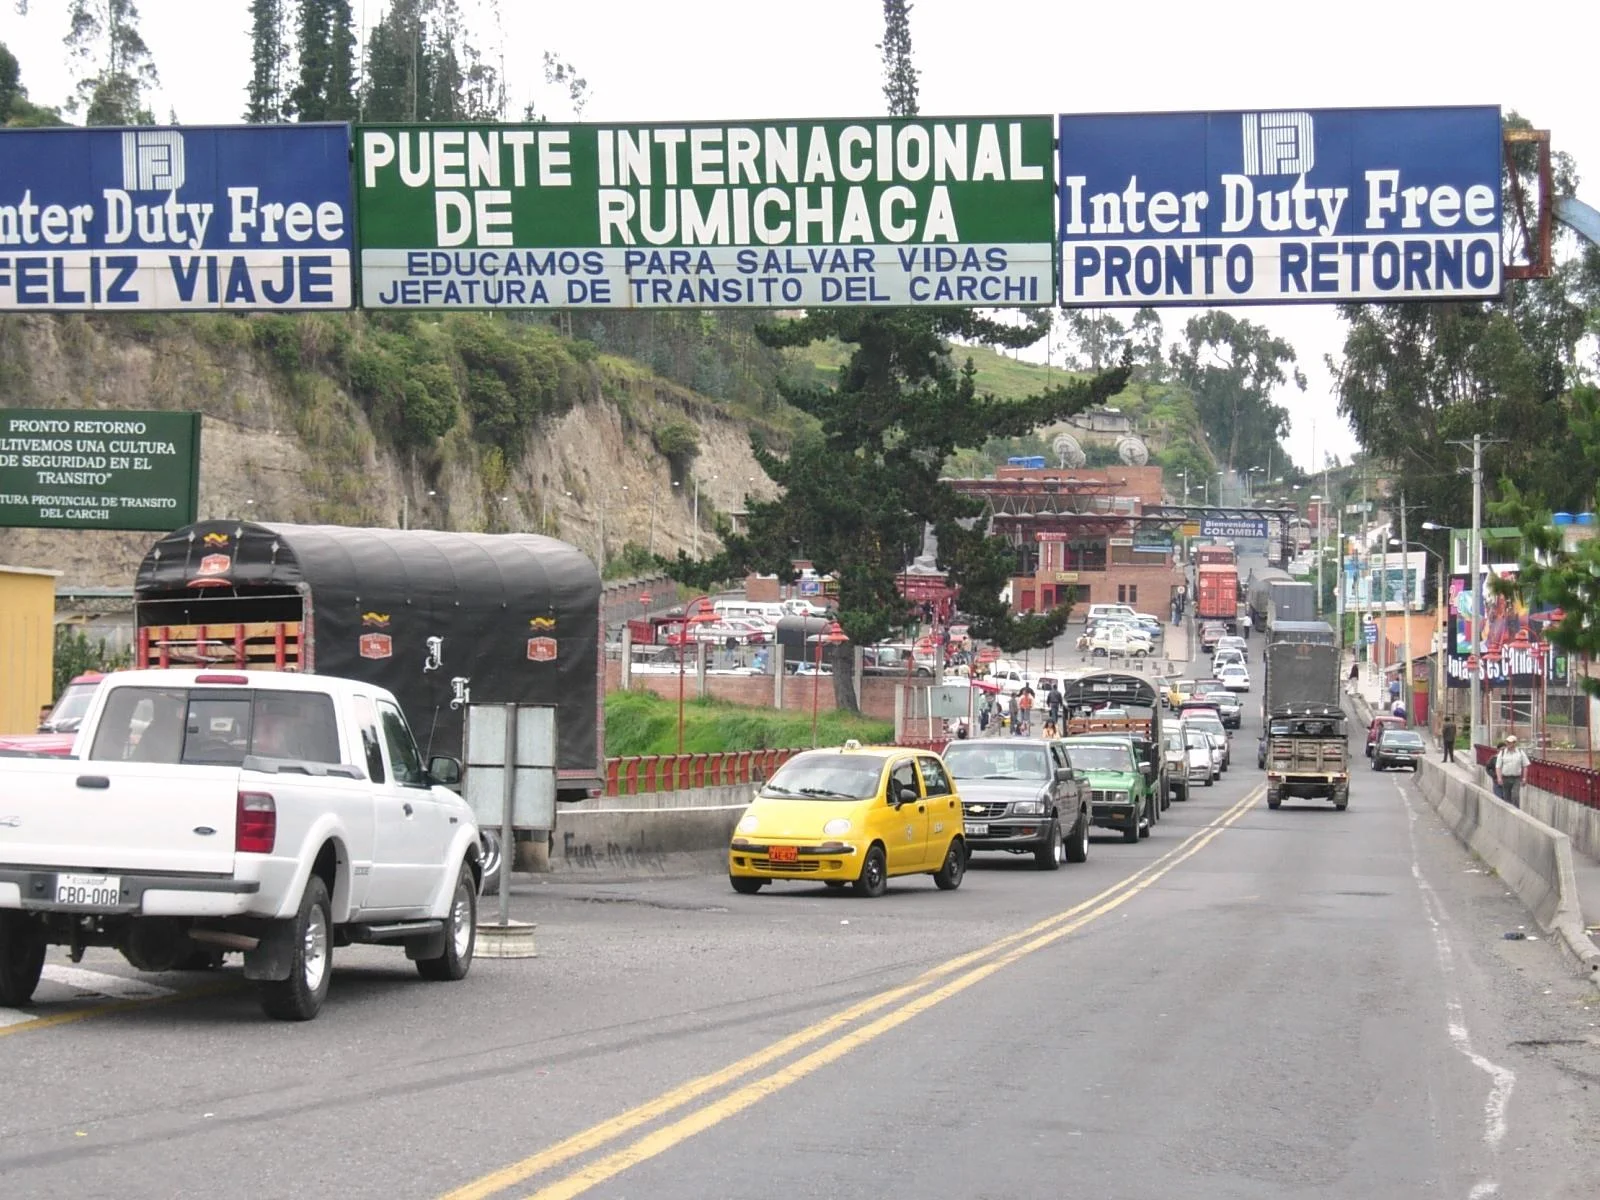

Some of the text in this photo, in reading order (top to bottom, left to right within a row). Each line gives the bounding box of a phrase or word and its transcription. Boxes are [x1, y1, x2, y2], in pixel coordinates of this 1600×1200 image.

[363, 123, 1043, 187] PUENTE INTERNACIONAL
[103, 188, 213, 249] Duty
[227, 187, 344, 243] Free
[435, 186, 959, 247] DE RUMICHACA
[1066, 170, 1496, 237] Inter Duty Free
[407, 247, 1007, 276] EDUCAMOS PARA SALVAR VIDAS
[1074, 238, 1494, 296] PRONTO RETORNO
[169, 255, 333, 304] VIAJE
[379, 276, 1038, 305] JEFATURA DE TRANSITO DEL CARCHI
[9, 420, 147, 435] PRONTO RETORNO
[0, 454, 152, 470] DE SEGURIDAD EN EL
[76, 440, 105, 453] UNA
[109, 441, 176, 455] CULTURA
[31, 495, 98, 507] PROVINCIAL
[101, 497, 118, 507] DE
[120, 497, 176, 508] TRANSITO
[40, 508, 109, 519] DEL CARCHI
[1203, 528, 1264, 537] COLOMBIA
[1205, 520, 1255, 529] Bienvenidos
